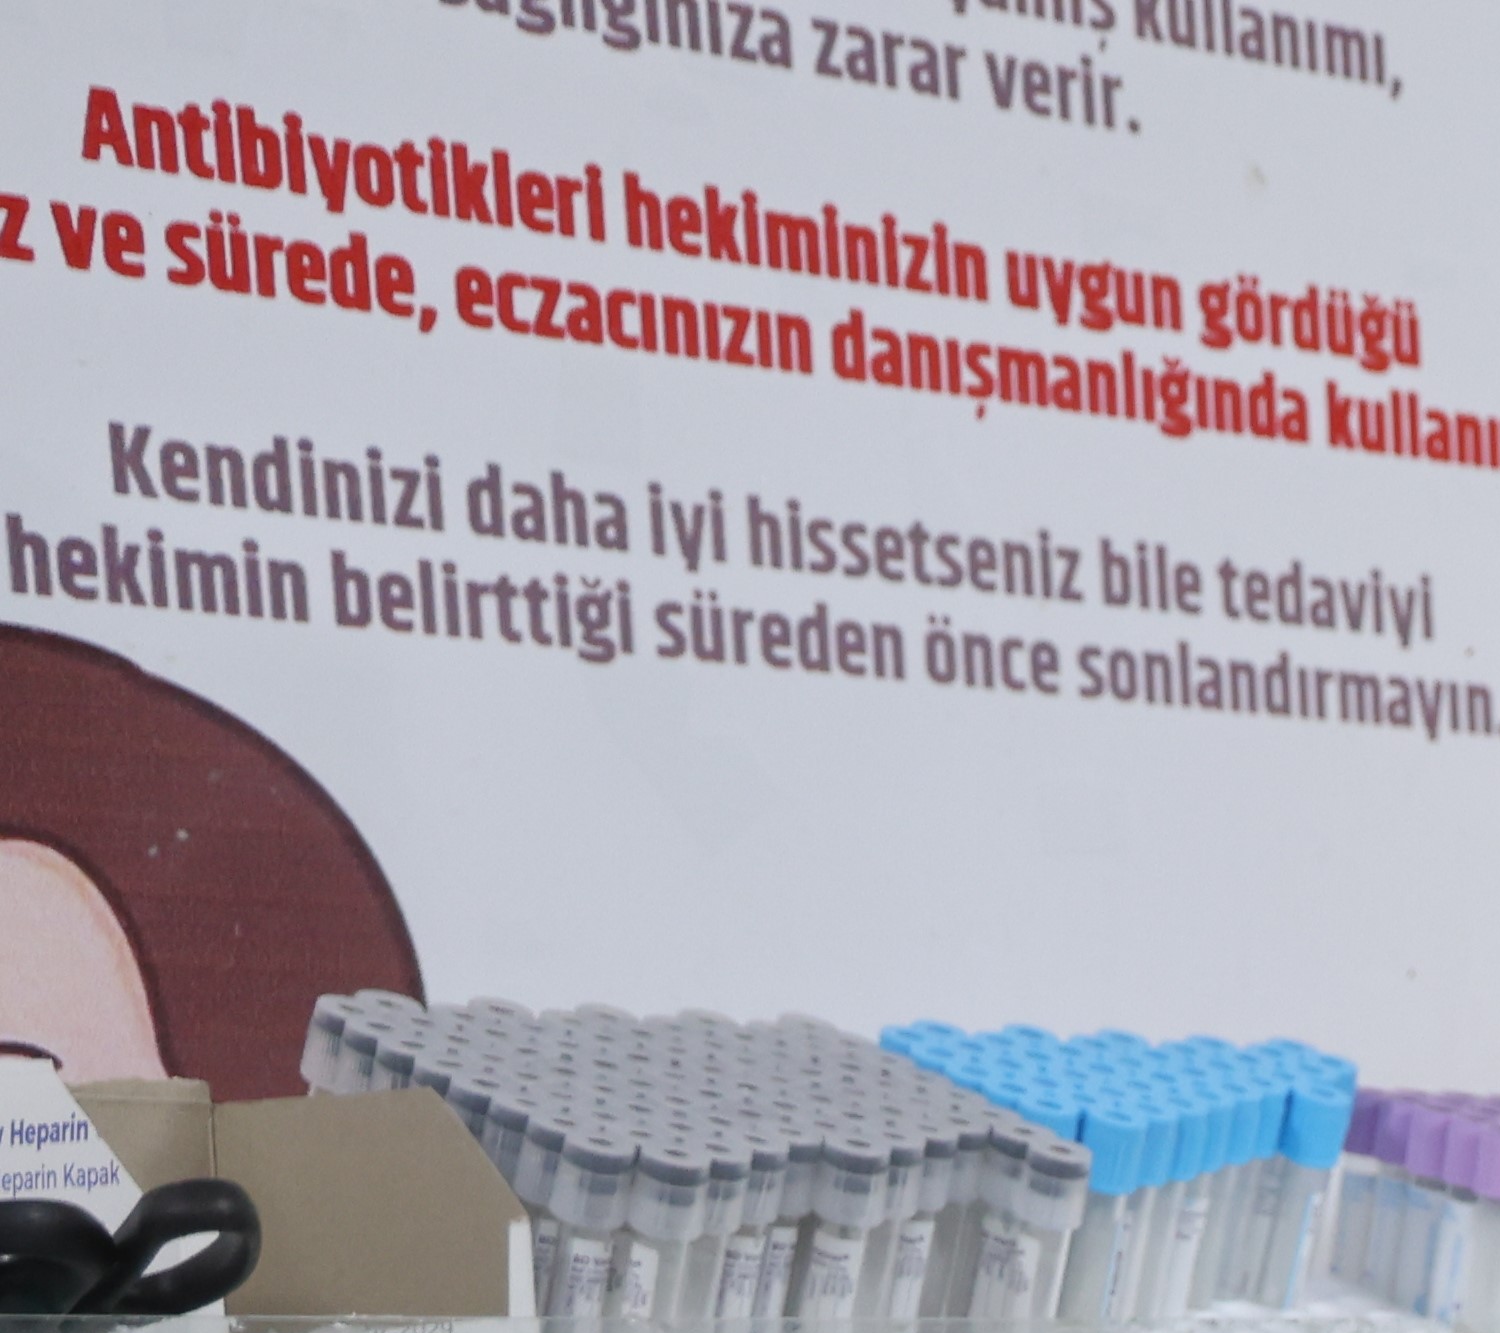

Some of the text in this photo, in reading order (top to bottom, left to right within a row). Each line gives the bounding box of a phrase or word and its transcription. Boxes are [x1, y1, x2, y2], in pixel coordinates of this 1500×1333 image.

[438, 0, 793, 70] ığınıza
[810, 16, 967, 100] zarar
[983, 50, 1142, 134] verir.
[1134, 0, 1403, 101] kullanımı,
[82, 85, 1422, 373] Antibiyotikleri hekiminizin uygun gördüğü
[50, 200, 147, 279] ve
[165, 209, 439, 334] sürede,
[455, 264, 814, 375] eczacınızın
[831, 307, 1310, 442] danışmanlığında
[4, 513, 312, 625] hekimin
[329, 549, 636, 664] belirttiği
[655, 591, 905, 681] süreden
[925, 613, 1061, 696] önce
[108, 421, 1435, 649] Kendinizi daha iyi hissetseniz bile tedaviyi
[10, 1111, 89, 1151] Heparin
[63, 1159, 120, 1194] Kapak
